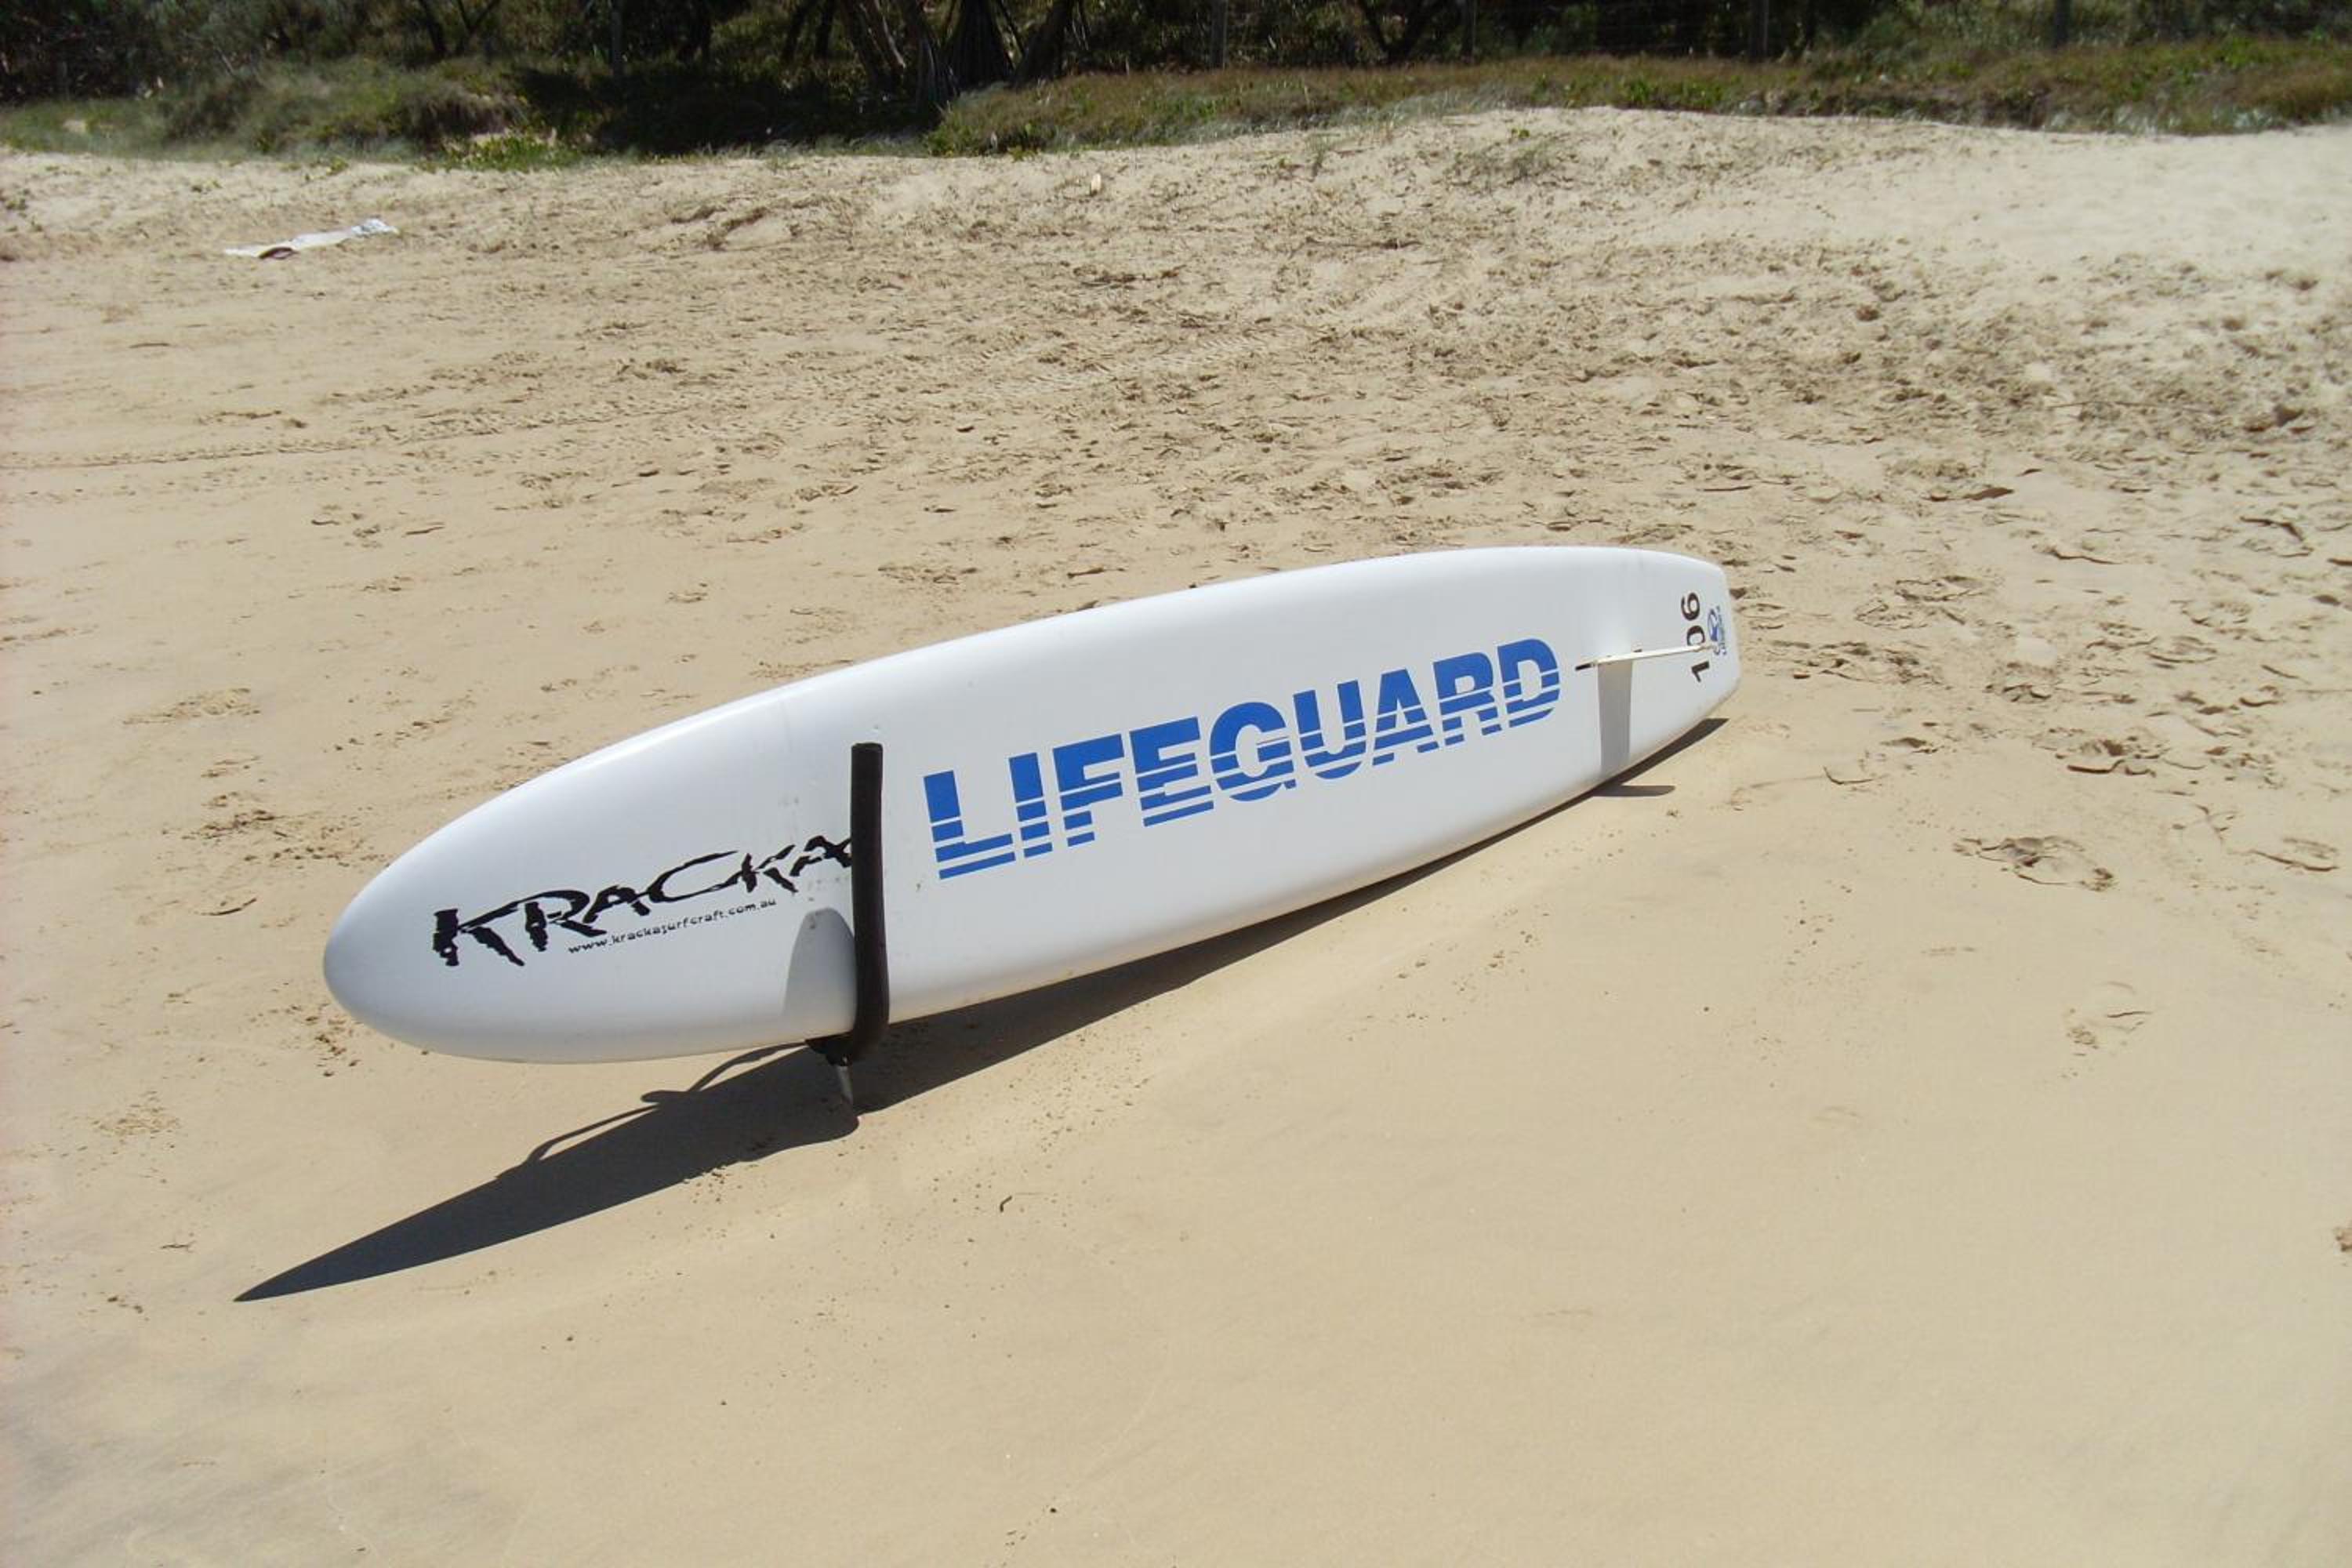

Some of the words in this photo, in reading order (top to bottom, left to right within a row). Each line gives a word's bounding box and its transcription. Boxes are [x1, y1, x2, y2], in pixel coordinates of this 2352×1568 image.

[1681, 592, 1710, 682] 106
[924, 638, 1560, 879] LIFEGUARD
[433, 835, 853, 966] KRACKA
[568, 898, 777, 953] www.krackasurfcraft.com.au
